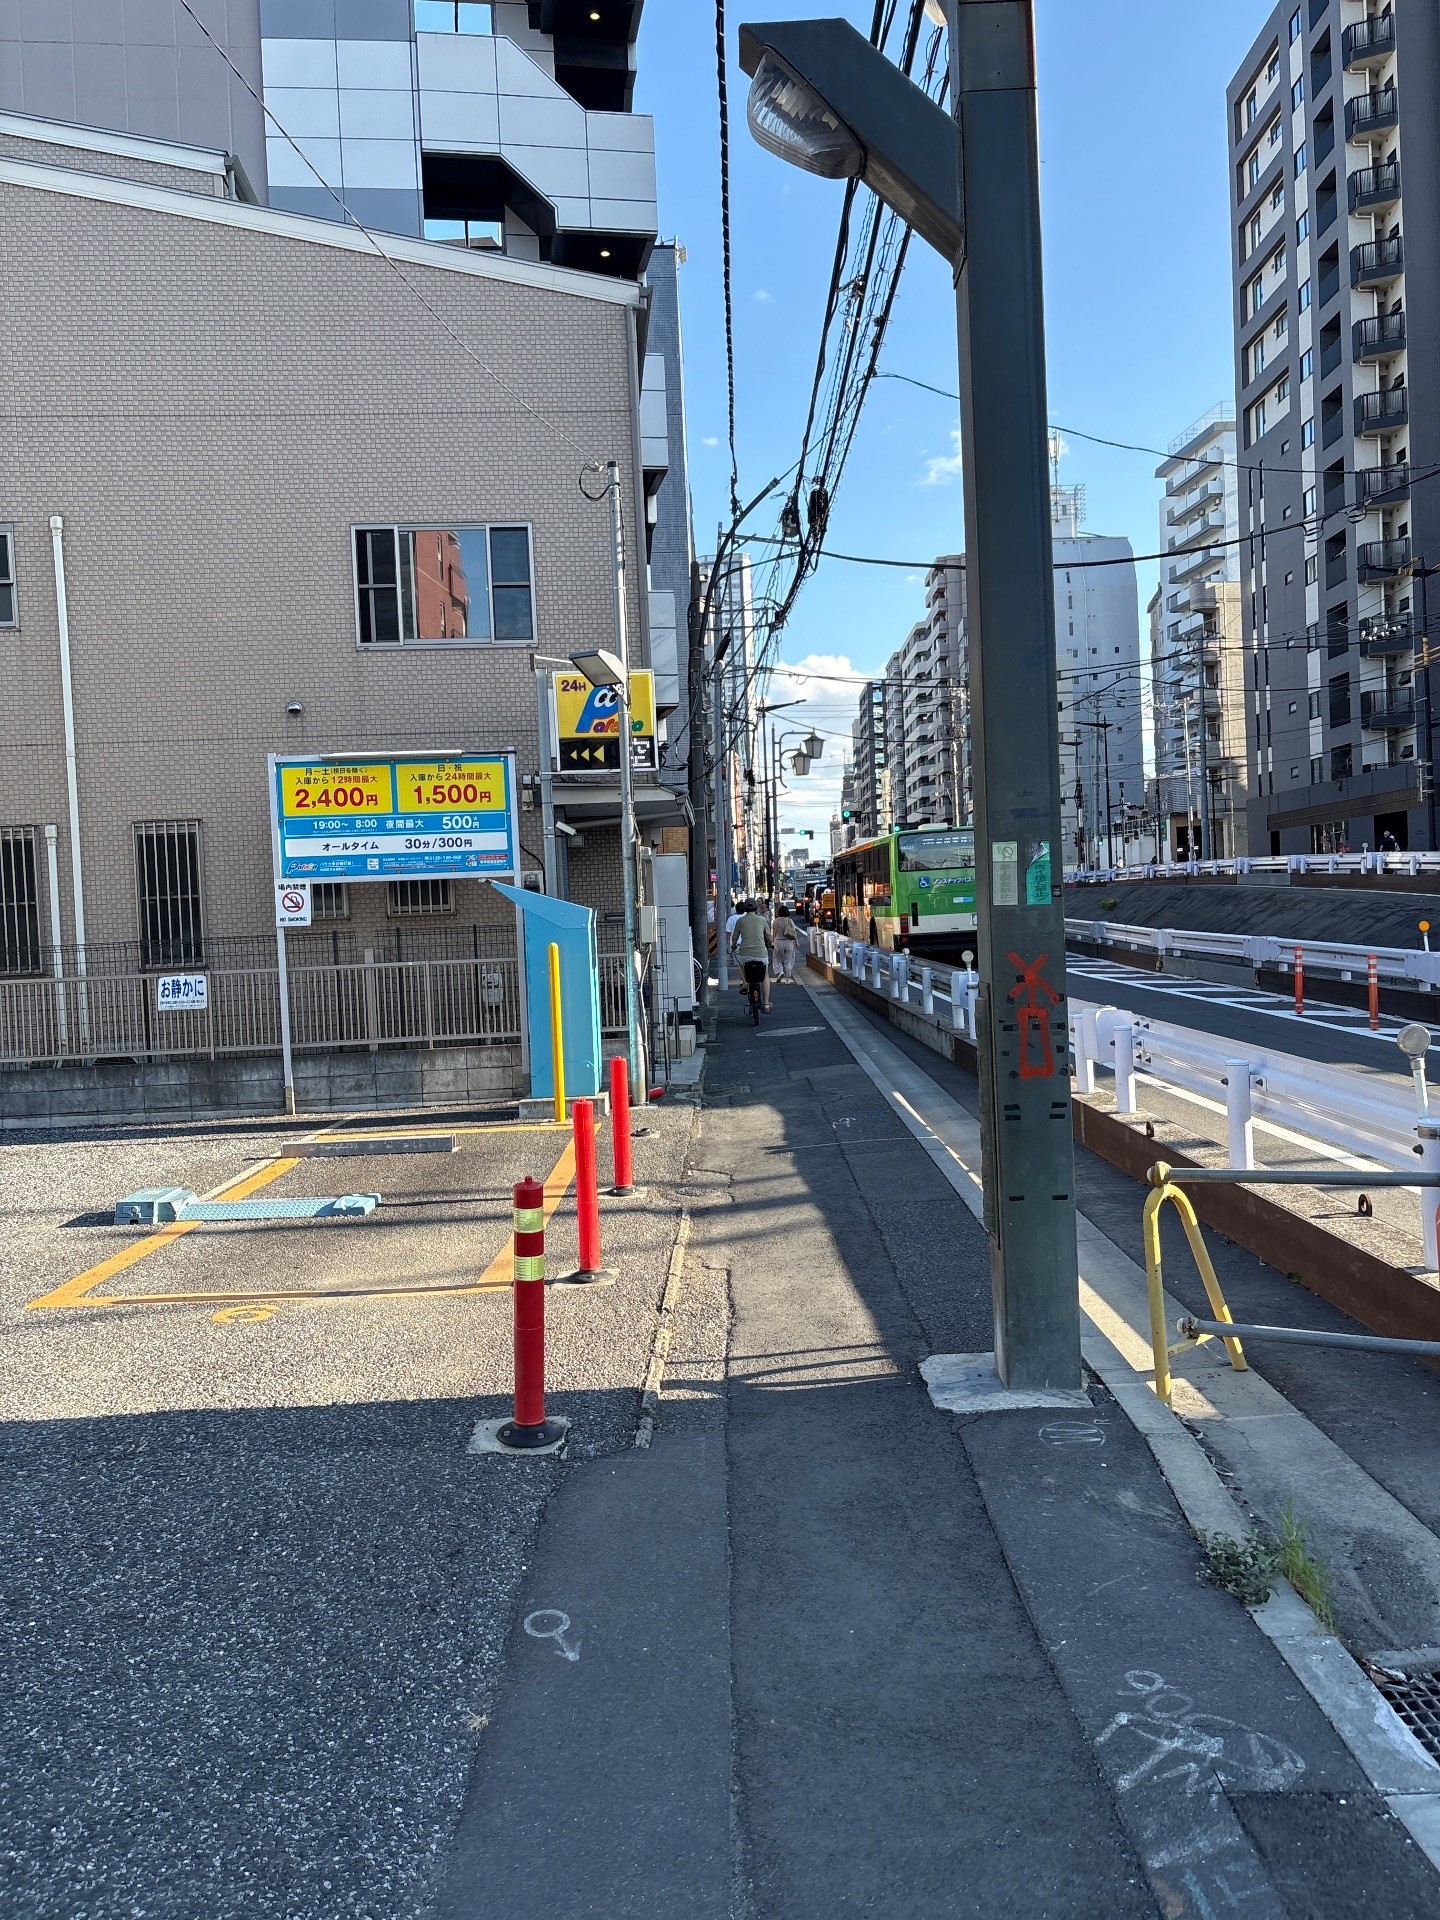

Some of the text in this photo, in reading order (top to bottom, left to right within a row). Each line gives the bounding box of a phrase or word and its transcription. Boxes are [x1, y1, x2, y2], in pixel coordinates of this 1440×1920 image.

[561, 680, 586, 692] 24H
[437, 764, 462, 772] 日・祝
[295, 786, 378, 808] 2,400円
[413, 783, 491, 805] 1,500円
[355, 818, 377, 828] 8:00
[386, 818, 424, 829] 夜間最大
[322, 841, 379, 852] オールタイム
[405, 837, 473, 850] 30分/300円
[278, 883, 307, 891] 場内禁煙
[161, 977, 204, 999] お静かに
